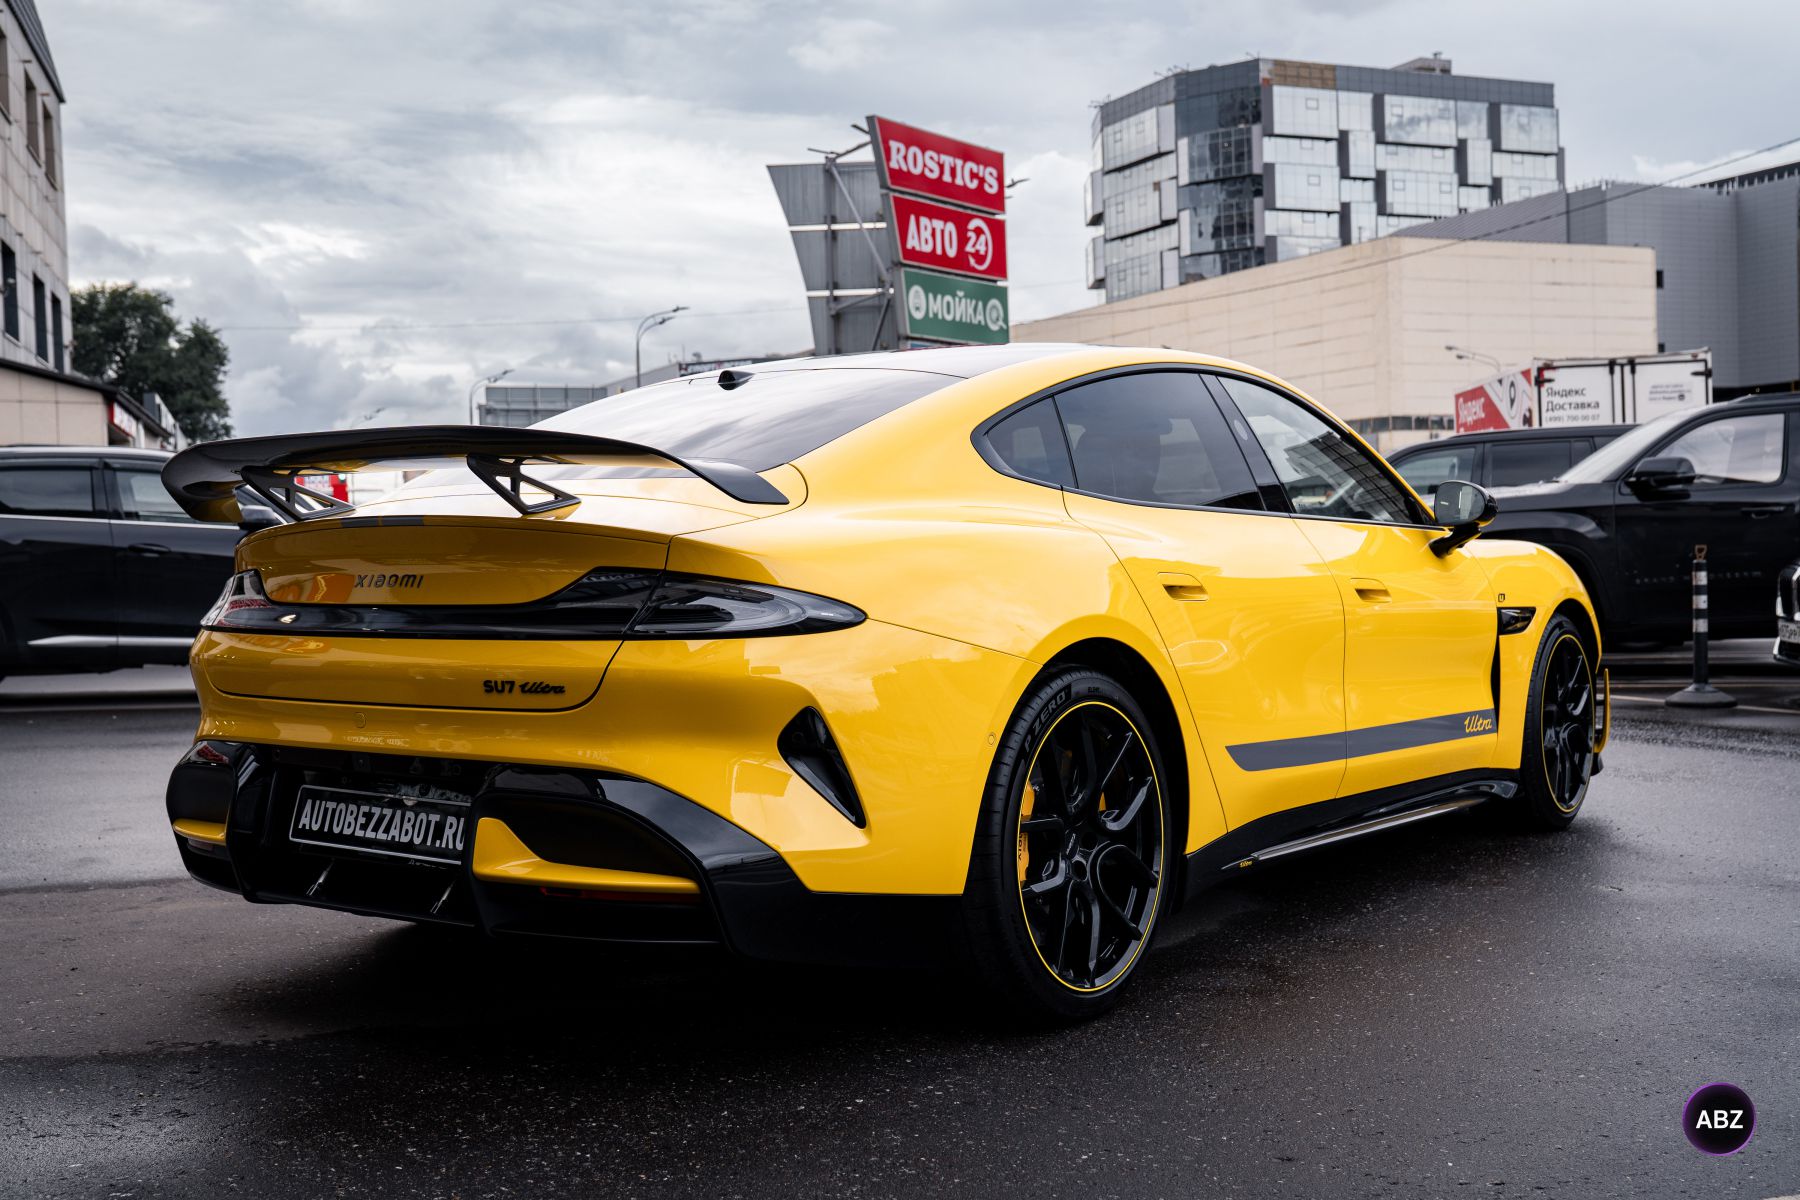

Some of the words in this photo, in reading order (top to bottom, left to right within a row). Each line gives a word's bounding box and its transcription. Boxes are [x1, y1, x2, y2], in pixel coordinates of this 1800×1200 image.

[888, 139, 999, 195] ROSTIC'S
[906, 214, 958, 258] АВТО
[965, 230, 987, 256] 24
[928, 290, 985, 327] МОЙКА
[1545, 400, 1600, 413] Доставка
[1546, 386, 1586, 398] Яндекс
[1458, 397, 1485, 426] Яндекс
[483, 680, 515, 694] SU7
[518, 680, 566, 695] Ultra
[1032, 690, 1066, 736] ZERO
[1464, 714, 1492, 733] Ultra
[298, 799, 465, 851] AUTOBEZZABOT.RU
